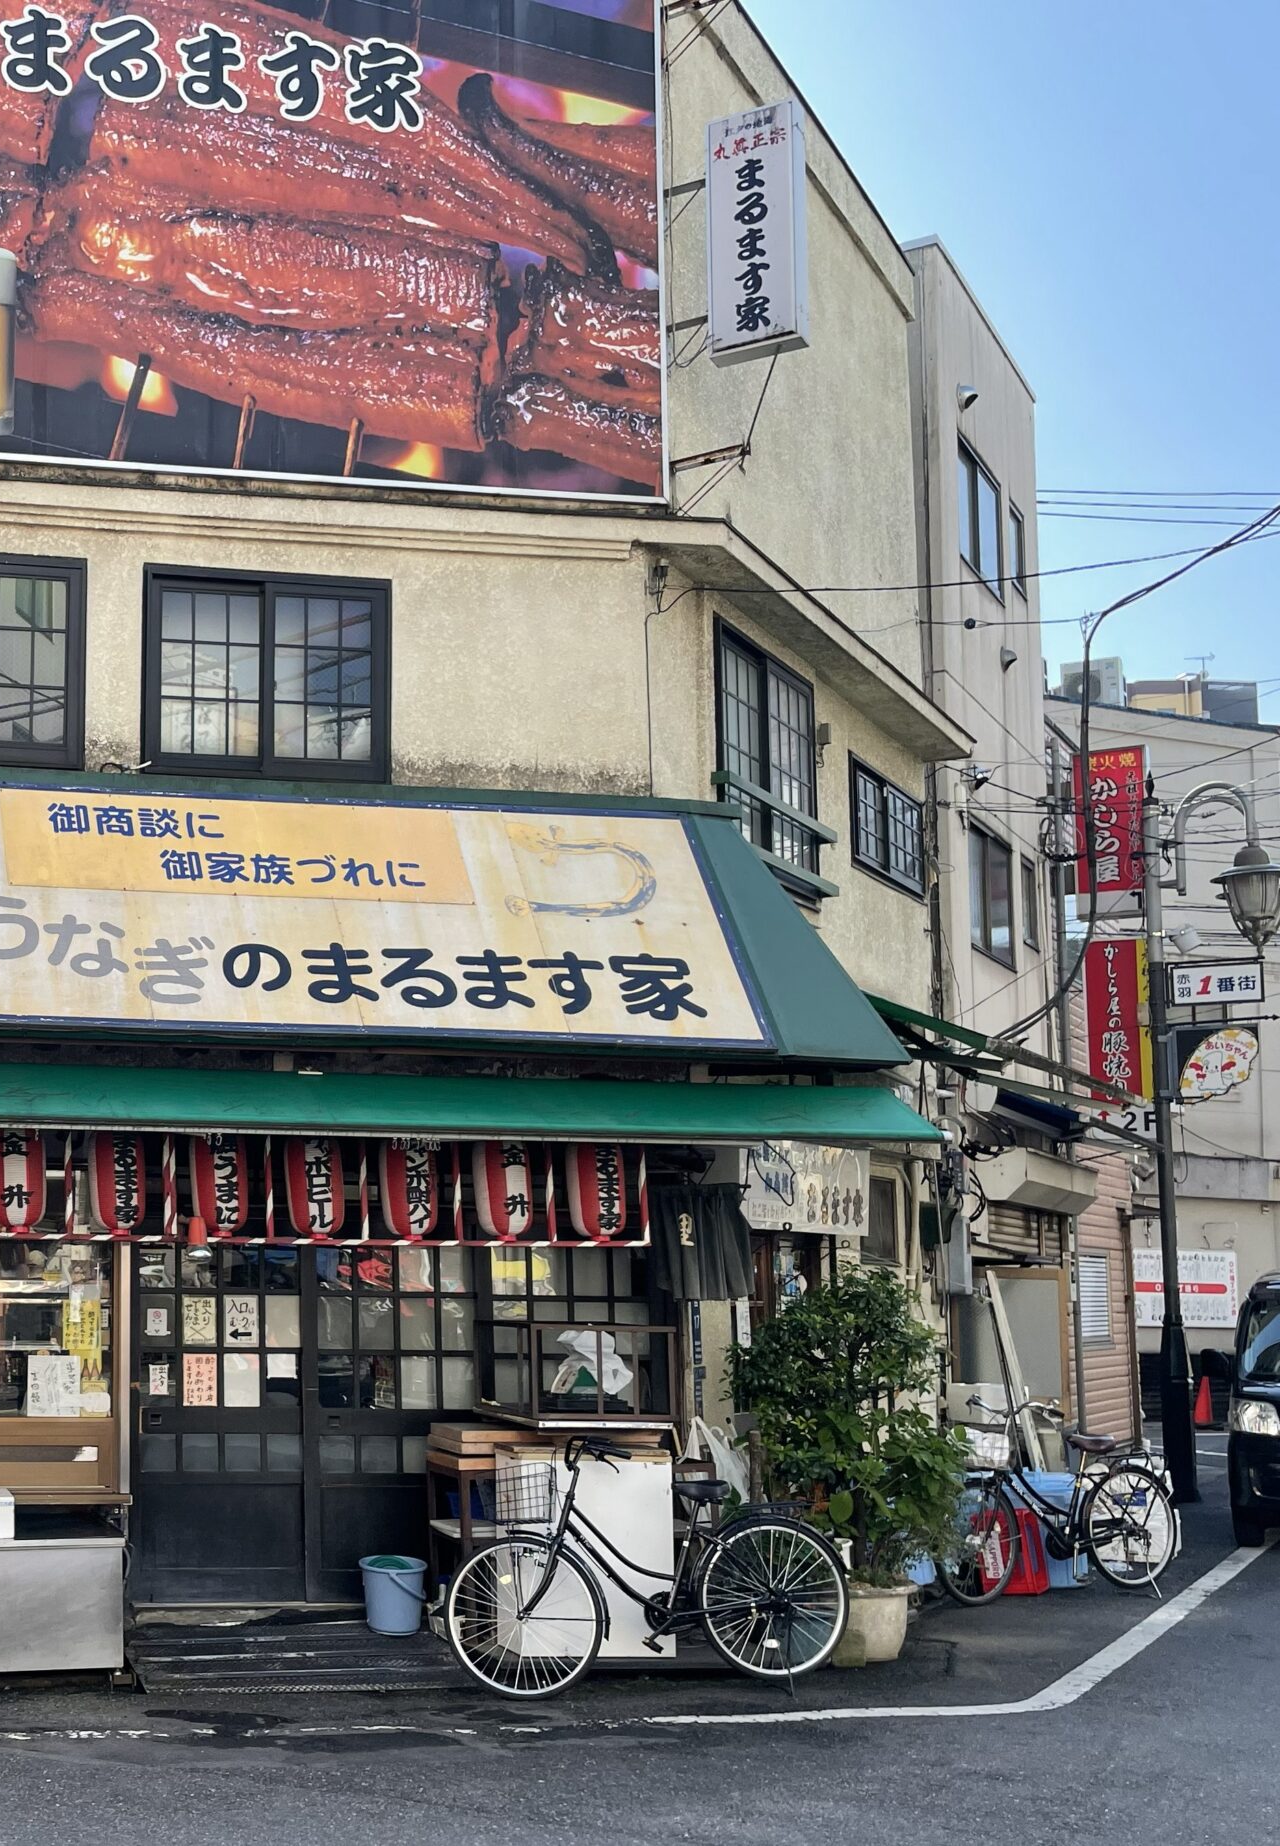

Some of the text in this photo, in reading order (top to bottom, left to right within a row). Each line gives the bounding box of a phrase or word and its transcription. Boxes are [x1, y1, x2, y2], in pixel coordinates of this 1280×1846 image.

[1, 6, 422, 131] まるます家
[734, 159, 770, 332] まるます家
[47, 801, 226, 842] 御商談に
[1090, 776, 1121, 883] かしら屋
[161, 849, 428, 890] 御家族づれに
[1177, 974, 1191, 998] 赤羽
[1196, 974, 1257, 996] 1番街
[1204, 1041, 1249, 1060] あいちゃん
[0, 1131, 33, 1208] 金升
[113, 1133, 140, 1224] まるます家
[501, 1146, 530, 1217] 金升
[595, 1146, 620, 1230] まるます家
[202, 1300, 212, 1326] 出入り
